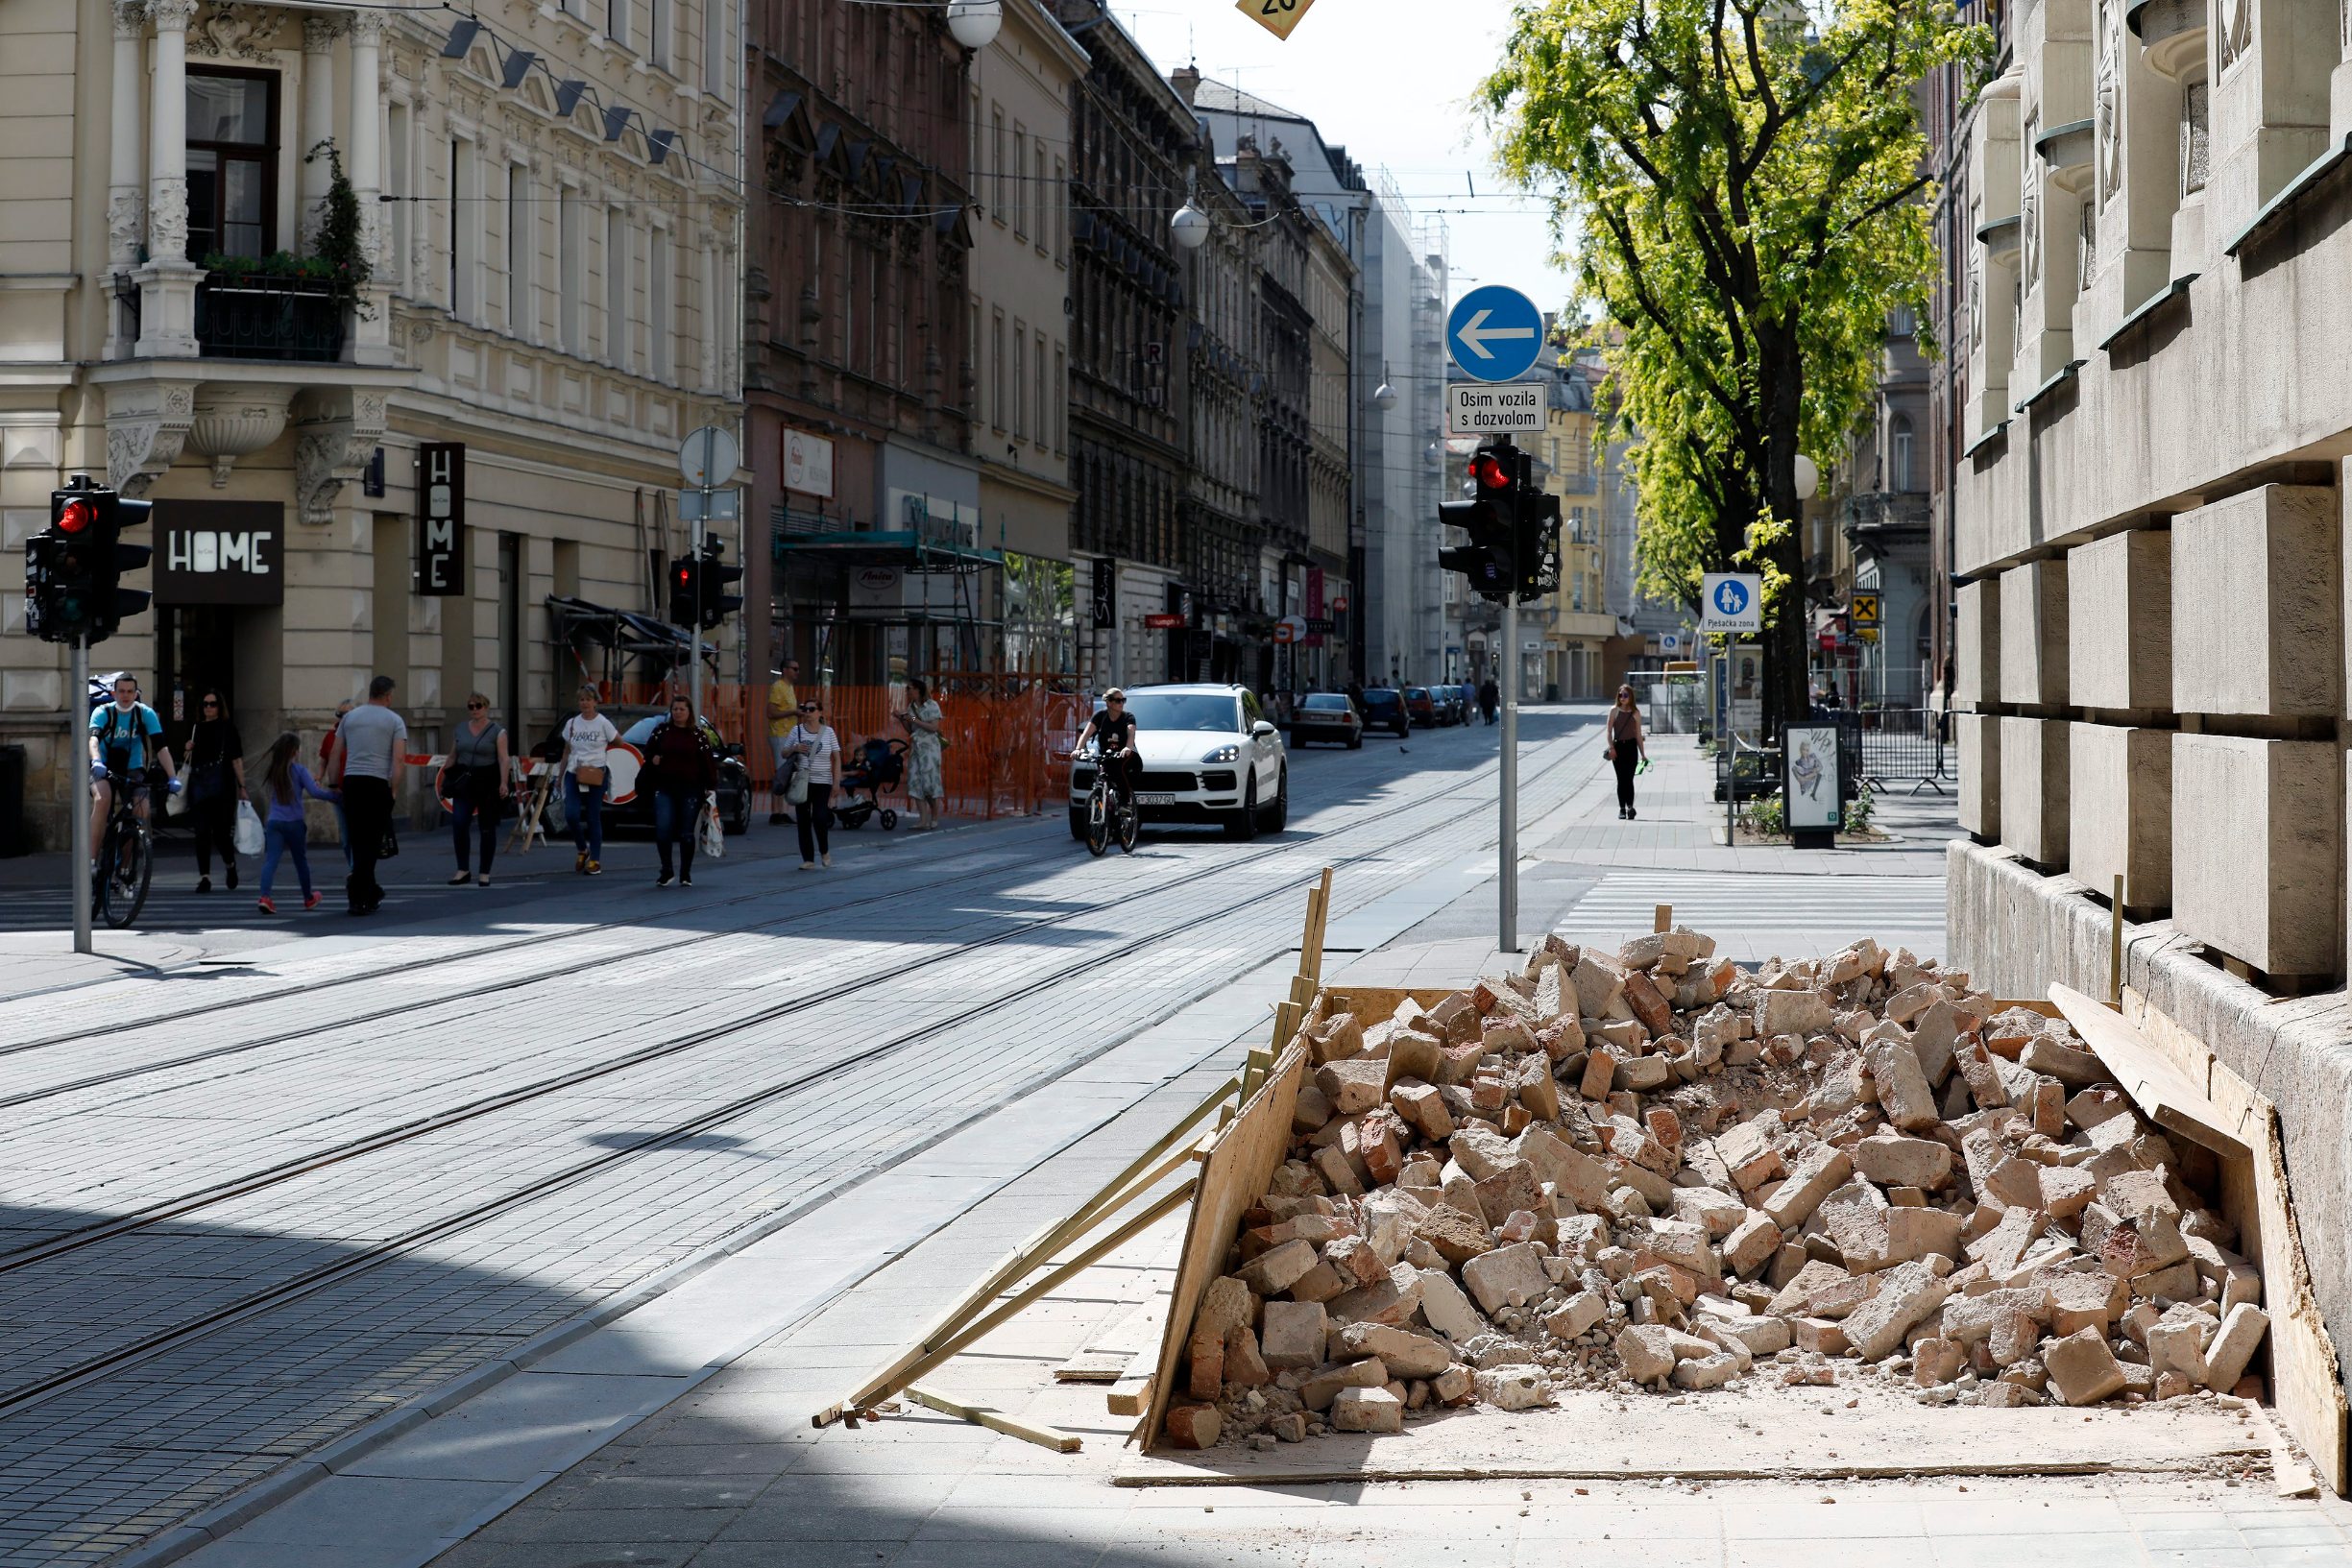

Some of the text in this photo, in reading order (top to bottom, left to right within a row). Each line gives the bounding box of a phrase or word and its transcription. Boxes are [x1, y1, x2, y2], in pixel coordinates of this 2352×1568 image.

[1460, 390, 1537, 407] Osim vozila
[1462, 410, 1536, 426] s dozvolom
[426, 449, 454, 589] HOME
[167, 529, 272, 574] HOME
[1708, 618, 1737, 629] Pješačka
